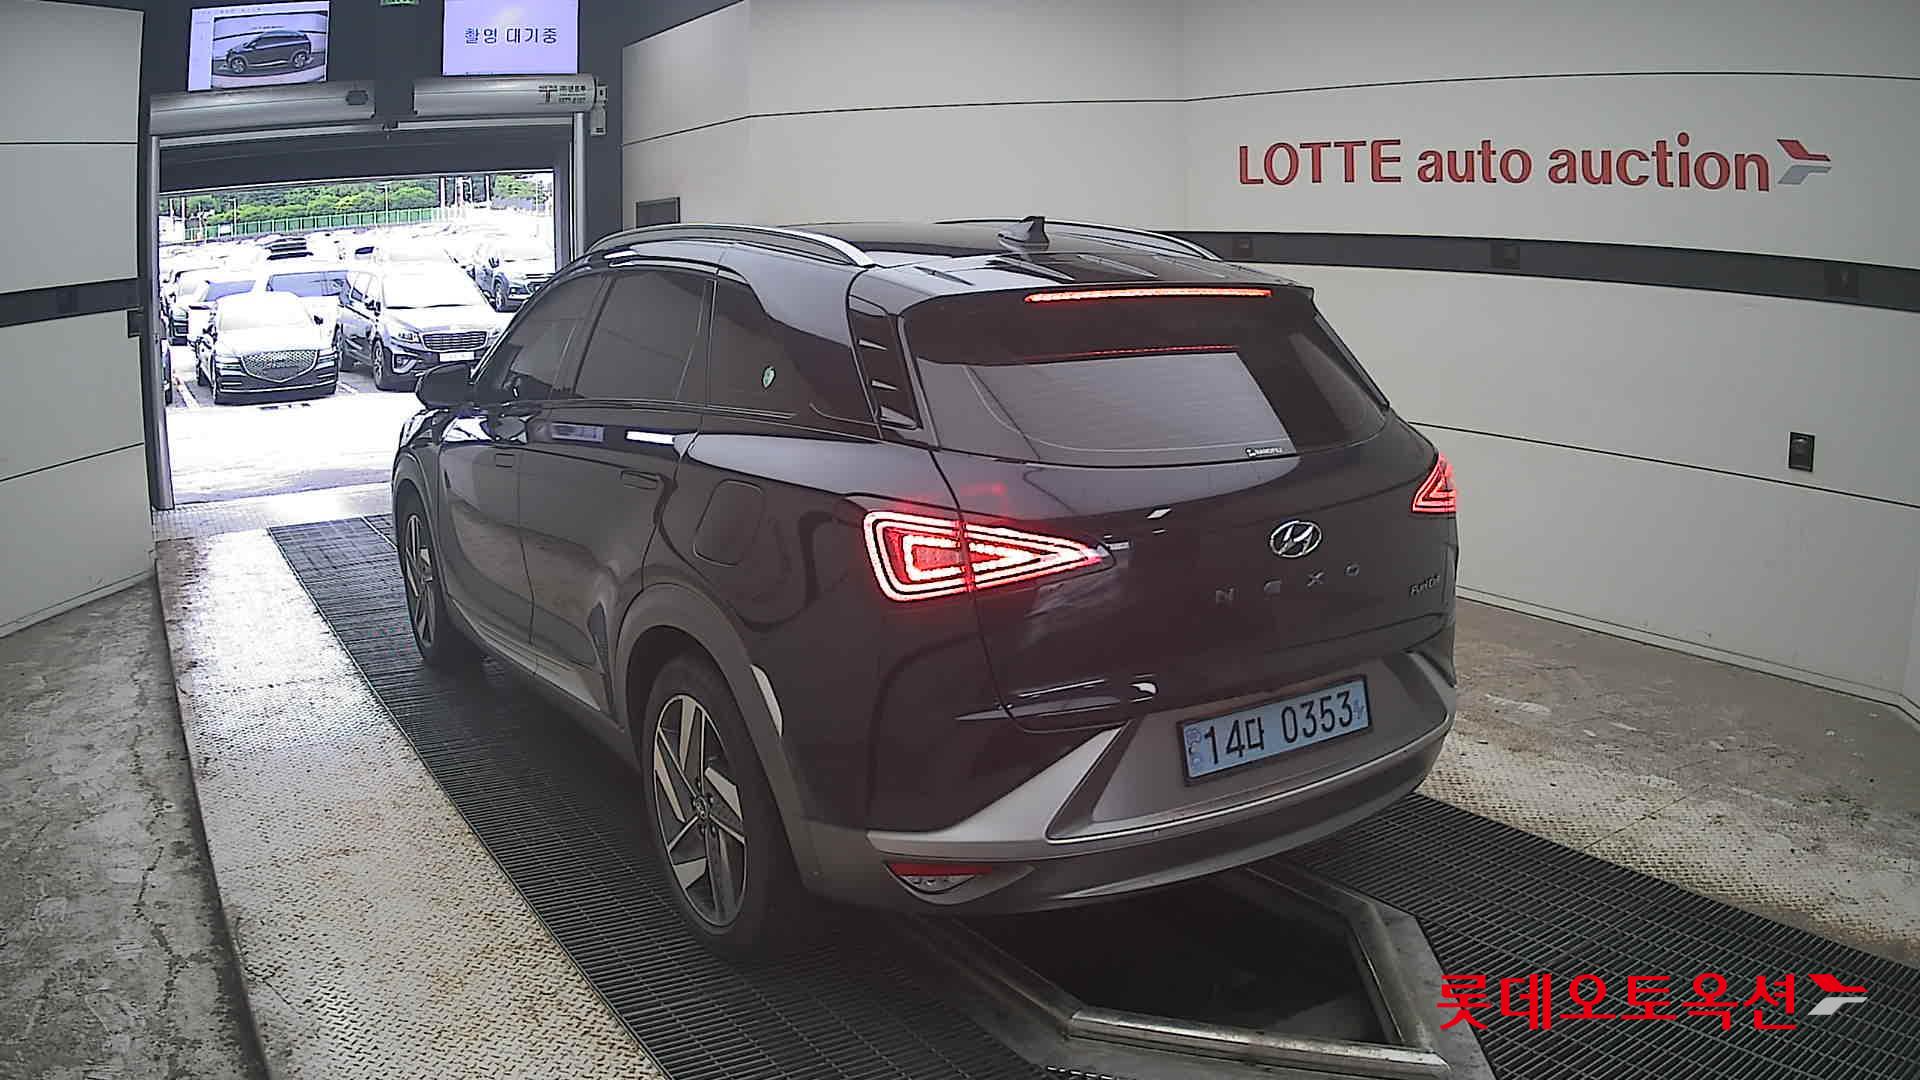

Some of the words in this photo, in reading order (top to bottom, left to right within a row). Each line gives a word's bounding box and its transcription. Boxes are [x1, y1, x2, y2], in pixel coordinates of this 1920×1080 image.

[506, 28, 557, 44] 대기중
[1239, 139, 1402, 185] LOTTE
[1417, 139, 1533, 184] auto
[1548, 132, 1770, 192] auction
[1204, 716, 1265, 765] 14다
[1280, 689, 1353, 744] 0353
